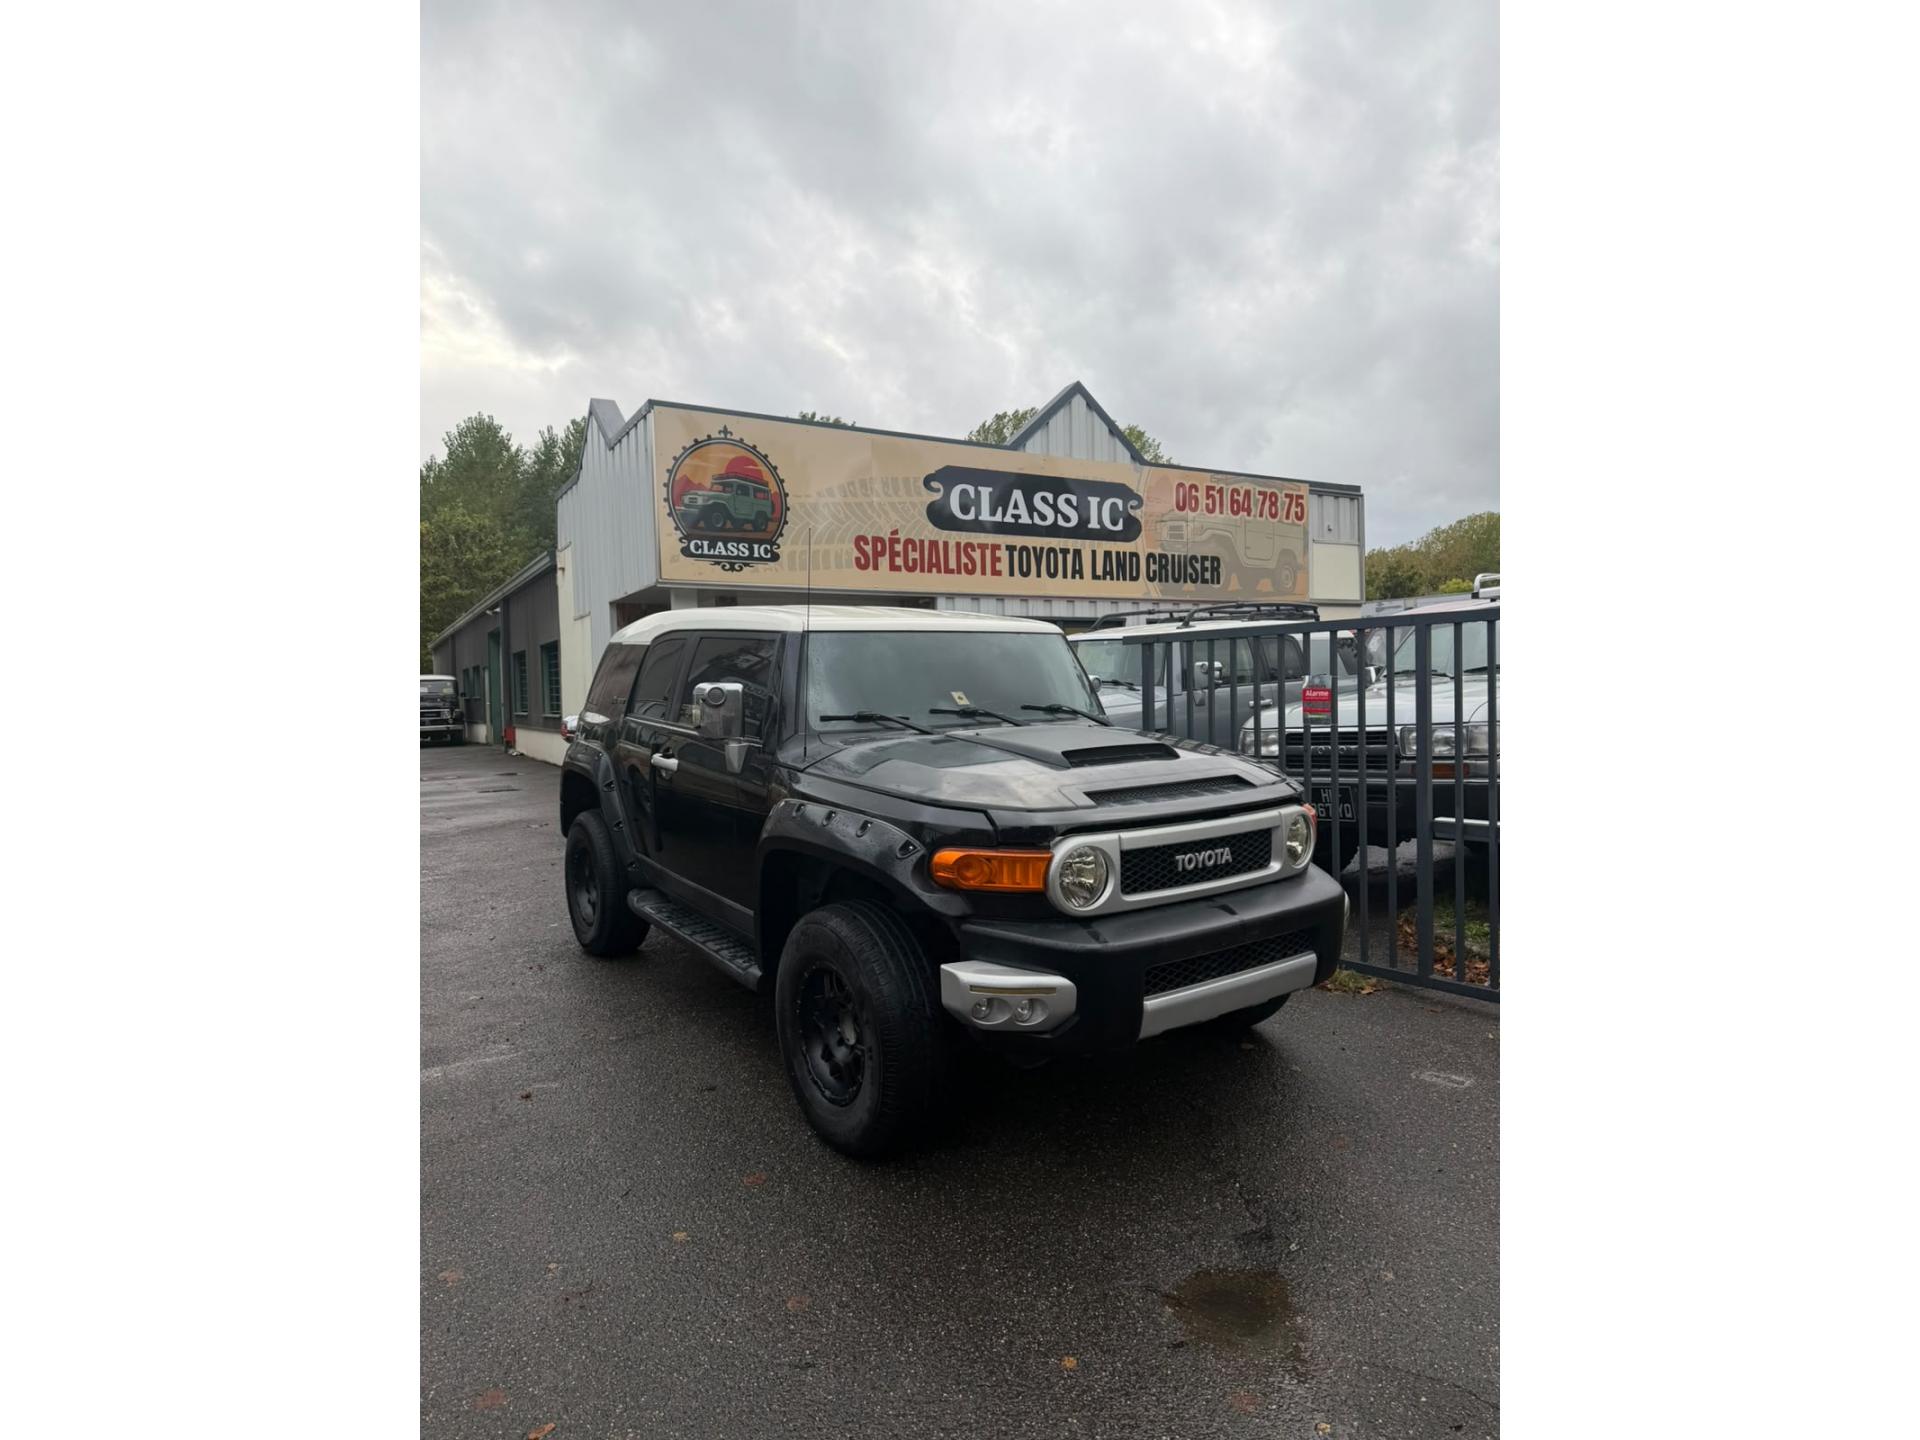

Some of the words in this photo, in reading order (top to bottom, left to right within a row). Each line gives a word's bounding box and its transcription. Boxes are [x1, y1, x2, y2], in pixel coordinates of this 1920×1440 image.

[950, 484, 1079, 528] CLASS
[1087, 496, 1124, 531] IC
[1175, 482, 1199, 513] 06
[1205, 485, 1224, 515] 51
[1229, 487, 1252, 517] 64
[1257, 490, 1279, 520] 78
[1284, 493, 1305, 522] 75
[689, 540, 750, 557] CLASS
[752, 544, 771, 559] IC
[854, 528, 1003, 577] SPÉCIALISTE
[1005, 544, 1084, 580] TOYOTA
[1091, 549, 1141, 582] LAND
[1146, 552, 1221, 585] CRUISER
[1305, 689, 1329, 697] Alarme
[1175, 847, 1233, 872] TOYOTA
